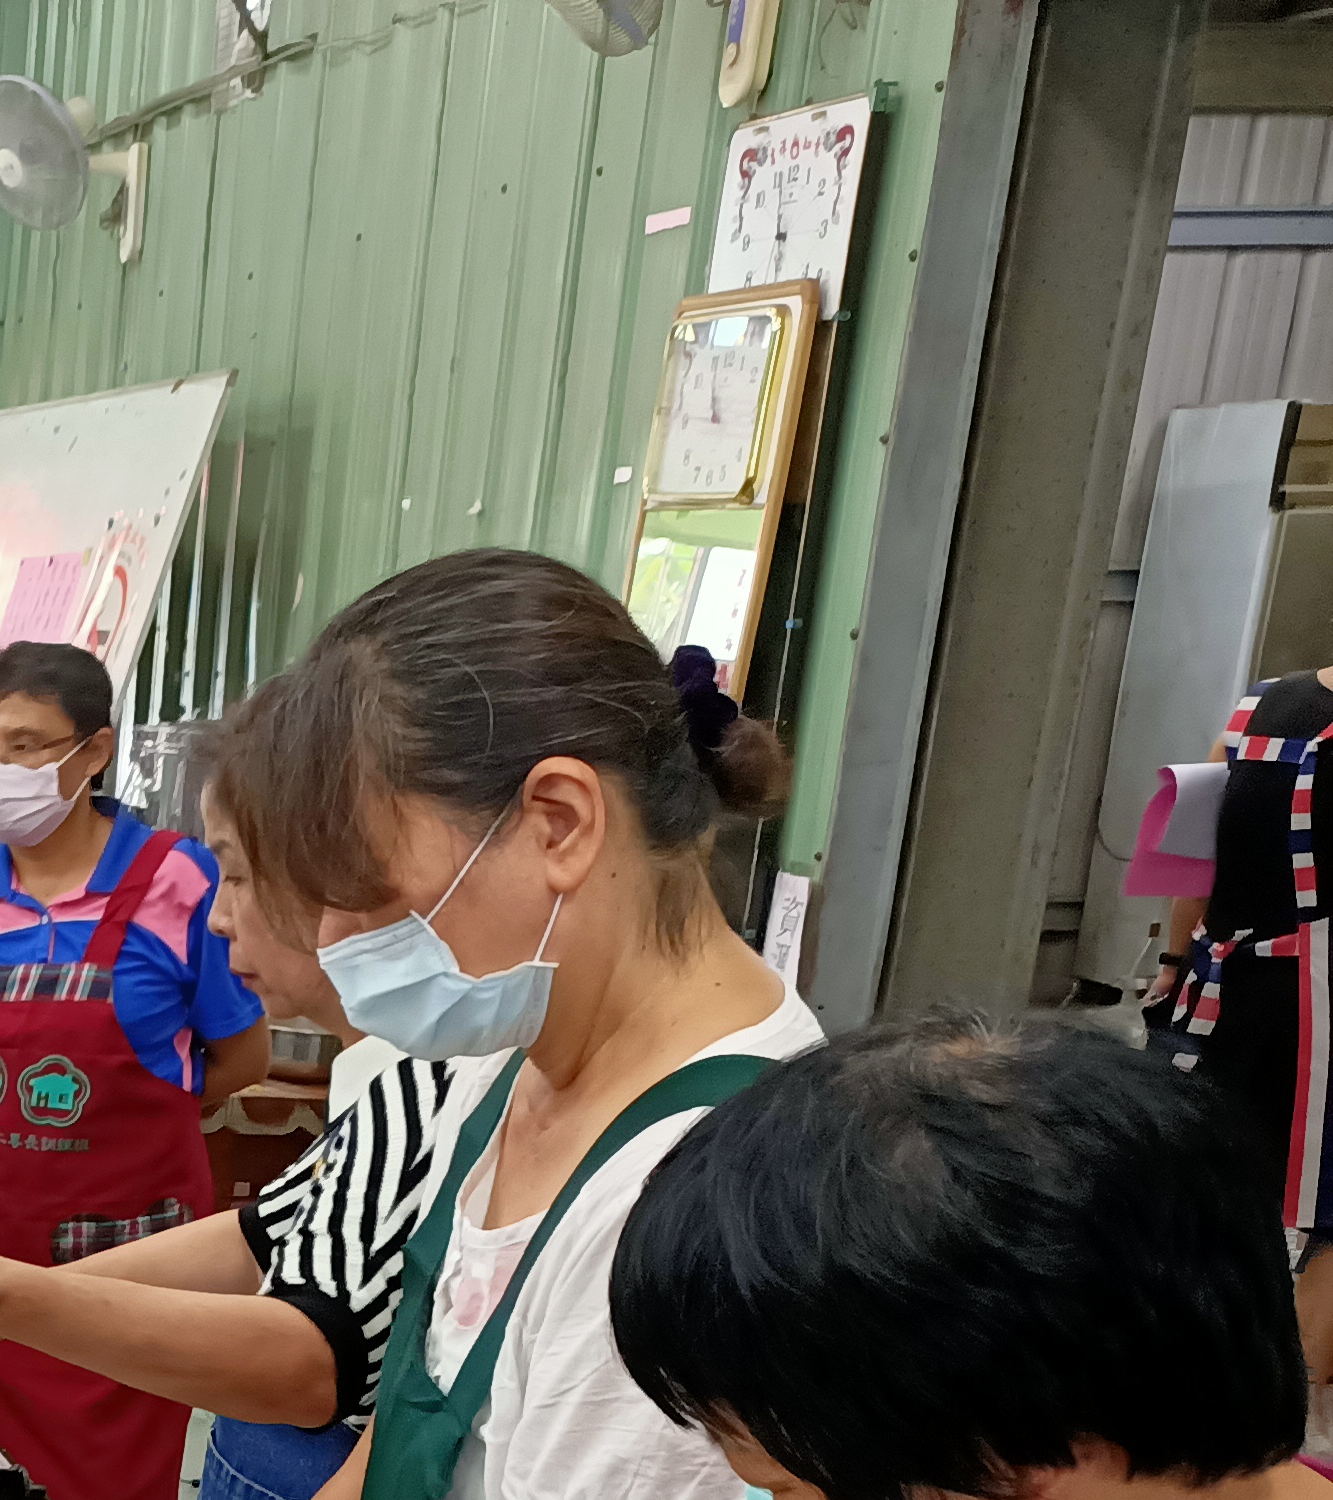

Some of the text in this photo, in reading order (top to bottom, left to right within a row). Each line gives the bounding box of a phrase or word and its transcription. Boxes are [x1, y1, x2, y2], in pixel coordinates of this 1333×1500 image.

[787, 164, 800, 183] 12
[806, 167, 812, 185] 1
[817, 178, 827, 197] 2
[755, 190, 766, 209] 10
[818, 219, 829, 239] 3
[693, 466, 702, 484] 7
